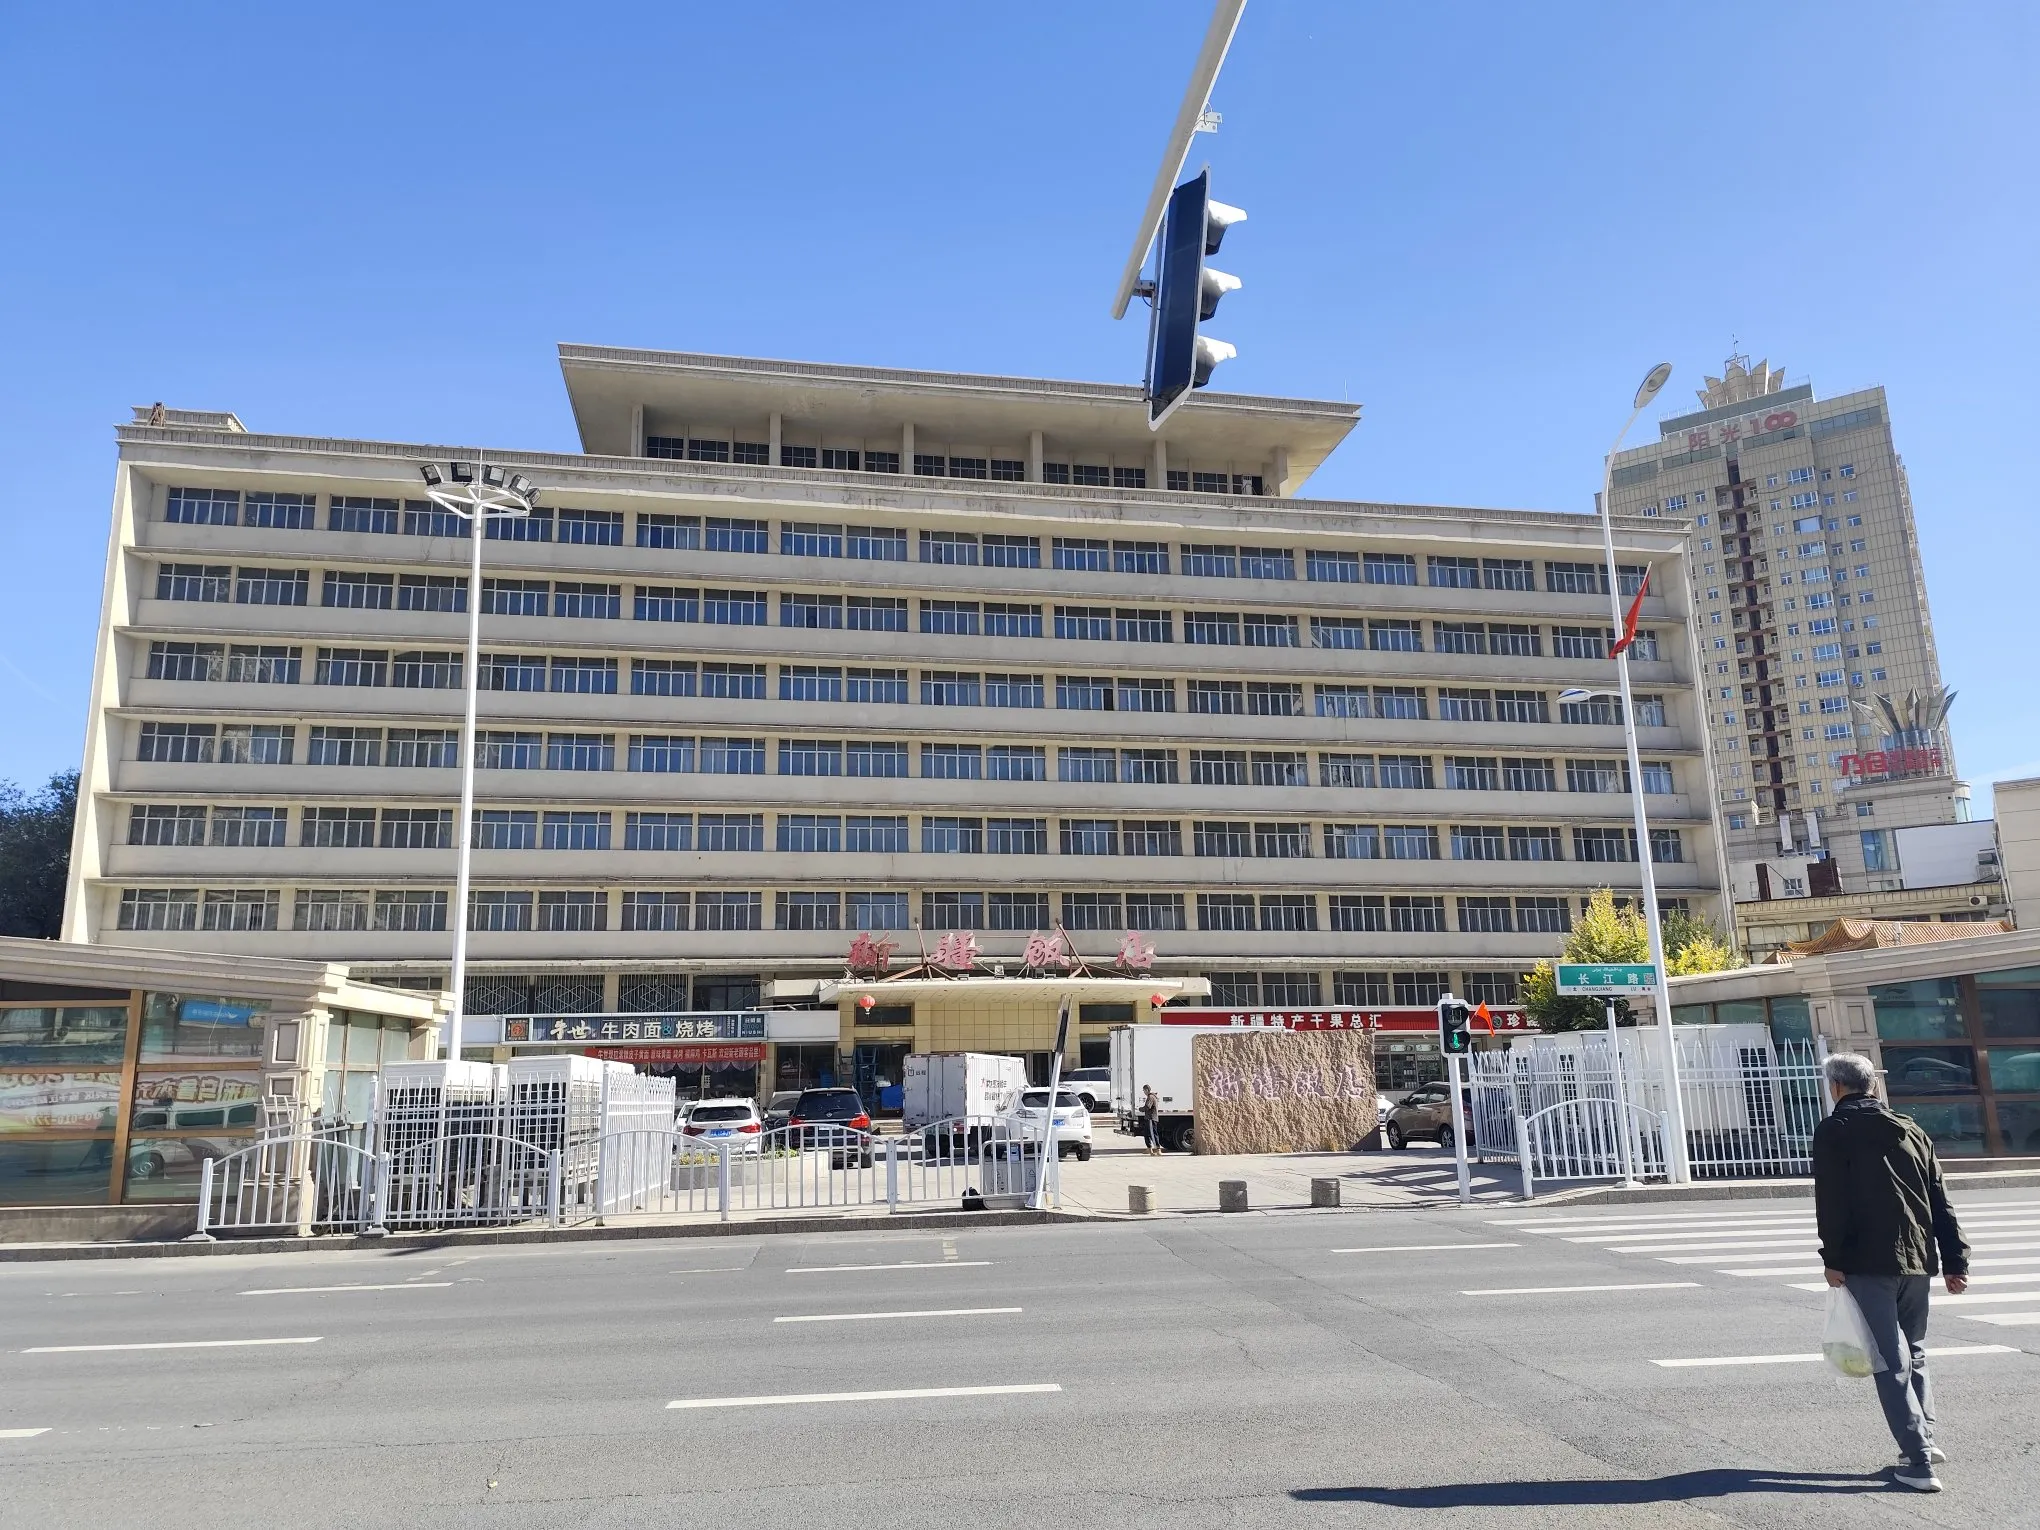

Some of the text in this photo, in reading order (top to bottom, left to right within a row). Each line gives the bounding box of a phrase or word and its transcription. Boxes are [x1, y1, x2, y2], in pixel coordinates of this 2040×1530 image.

[1578, 973, 1639, 984] 长江路
[1230, 1013, 1383, 1028] 新疆特产干果总汇
